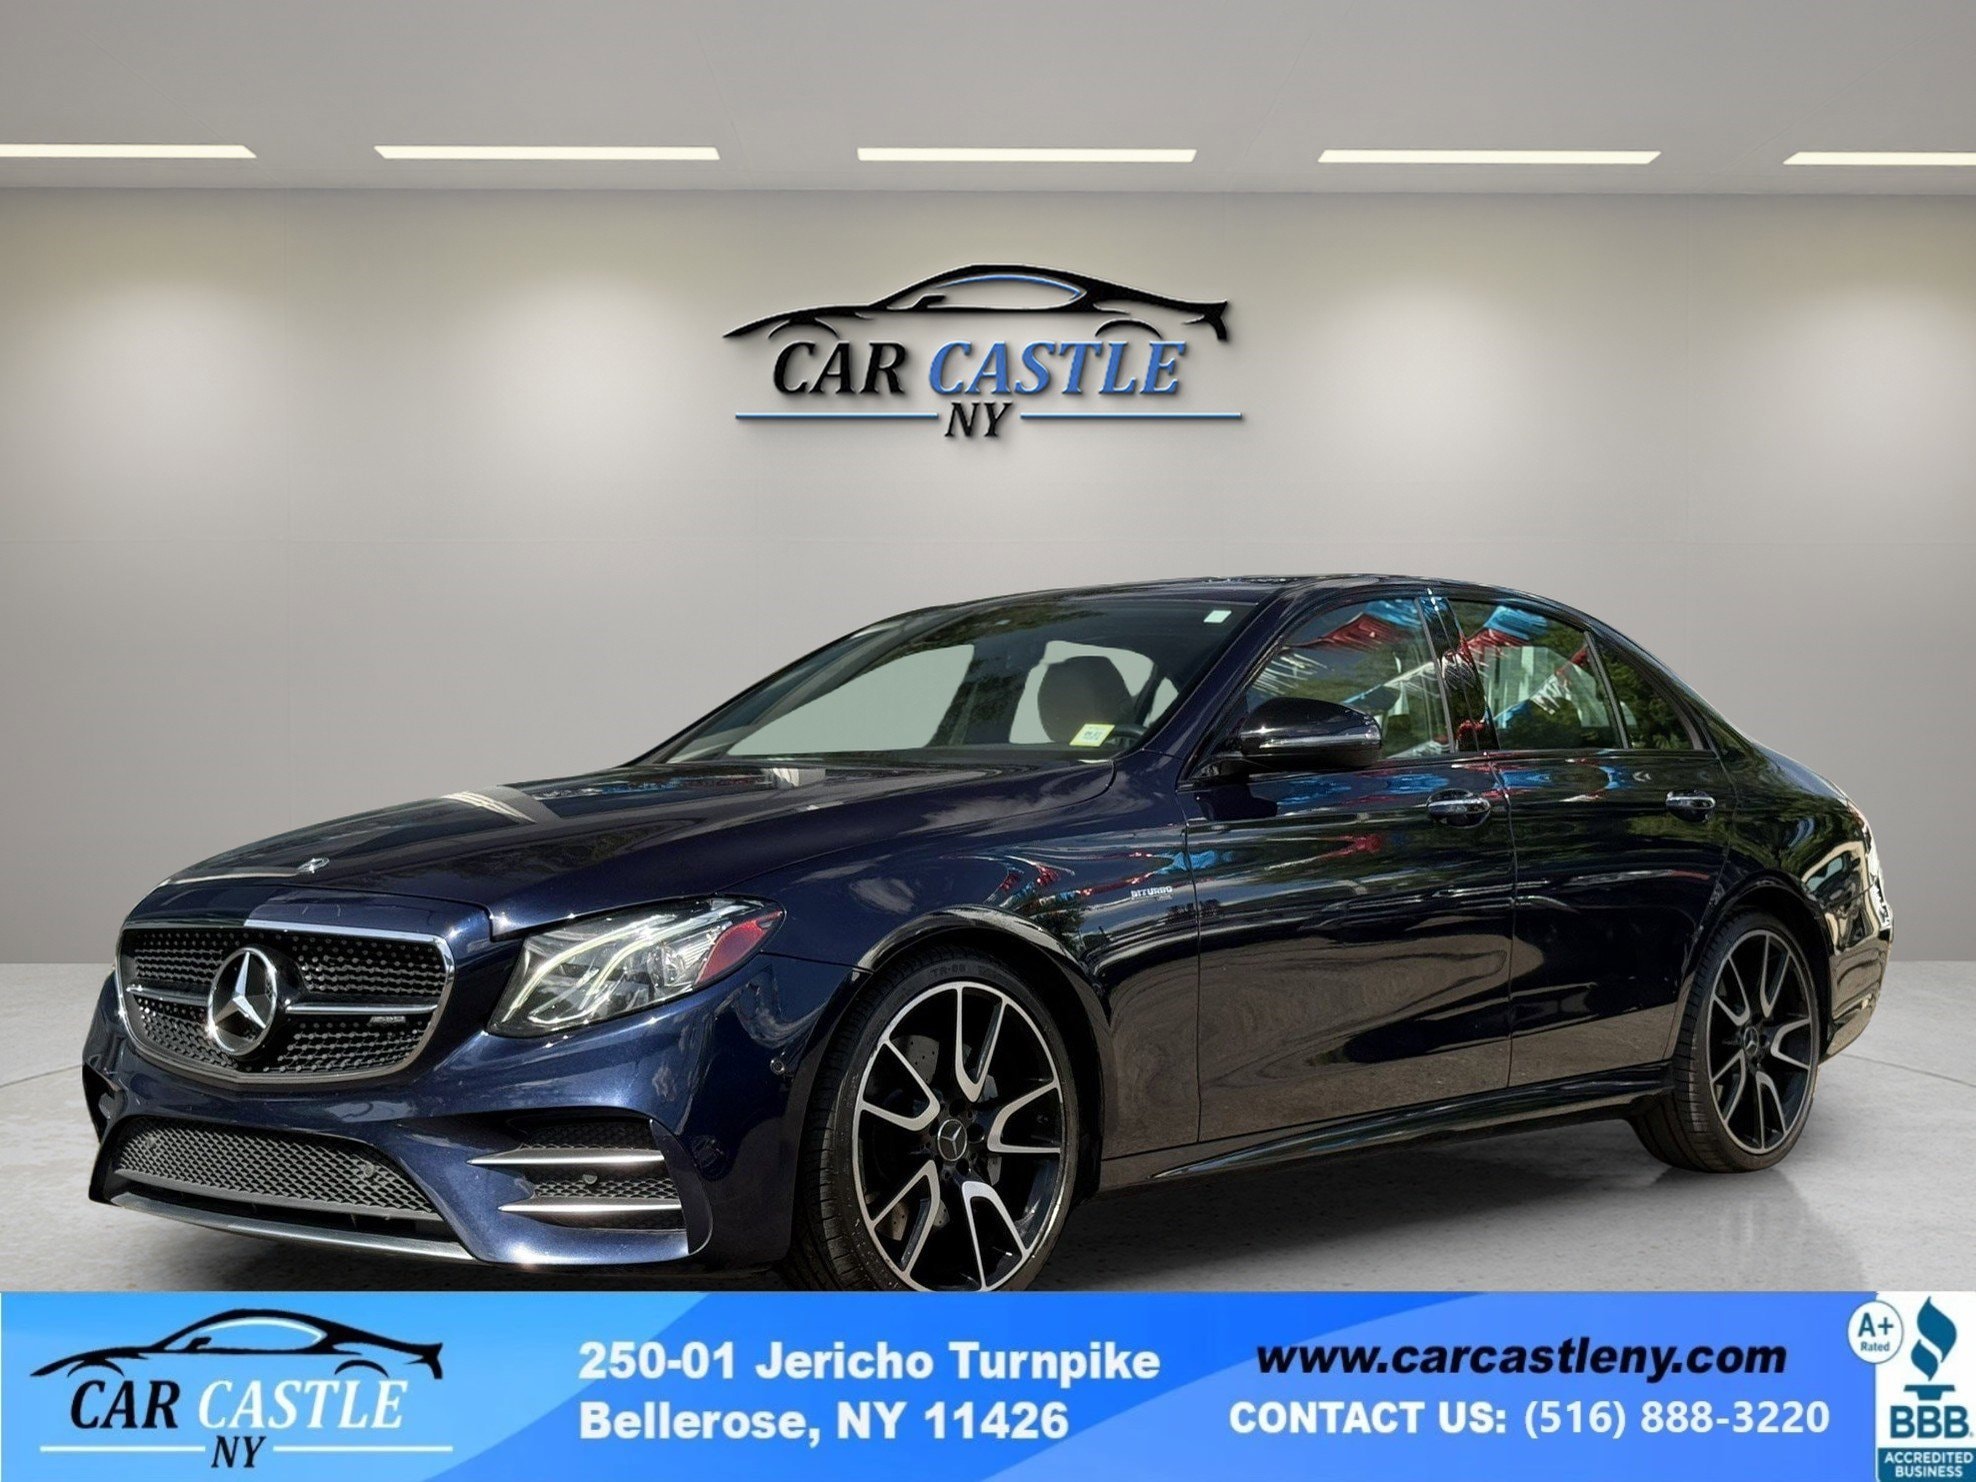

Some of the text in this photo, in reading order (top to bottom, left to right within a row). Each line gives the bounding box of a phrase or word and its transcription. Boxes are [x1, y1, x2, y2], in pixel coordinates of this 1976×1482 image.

[773, 341, 1187, 394] CAR CASTLE
[944, 402, 1013, 438] NY
[1130, 885, 1174, 898] BITURBO
